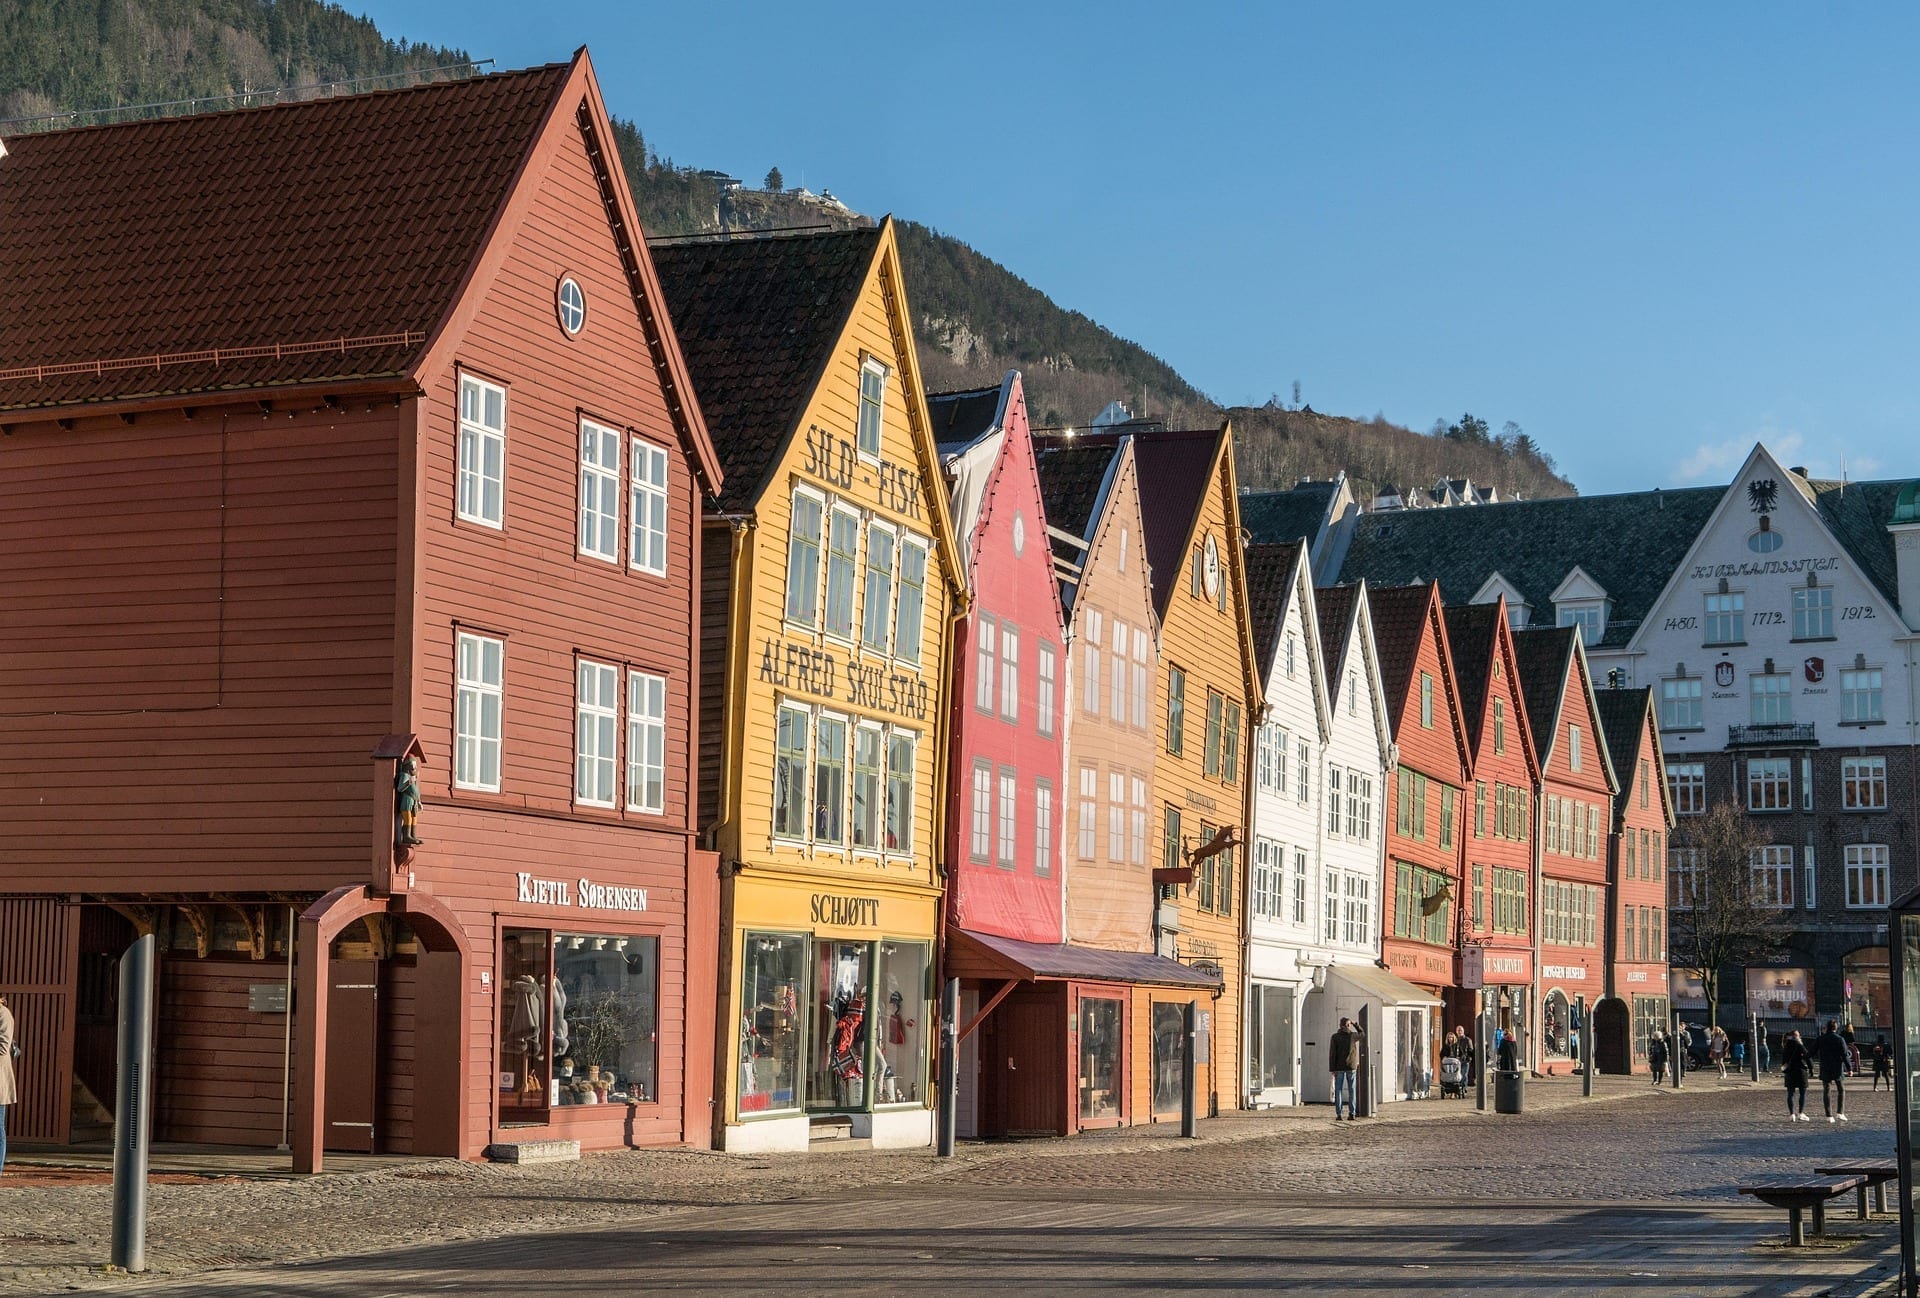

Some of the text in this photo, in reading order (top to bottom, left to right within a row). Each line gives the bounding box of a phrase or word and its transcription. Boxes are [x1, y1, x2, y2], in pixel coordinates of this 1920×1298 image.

[804, 423, 854, 490] SILD
[878, 458, 923, 521] FISK
[759, 636, 928, 721] ALFRED SKULSTAD
[517, 871, 648, 912] KJETIL SØRENSEN
[810, 892, 880, 928] SCHJØTT
